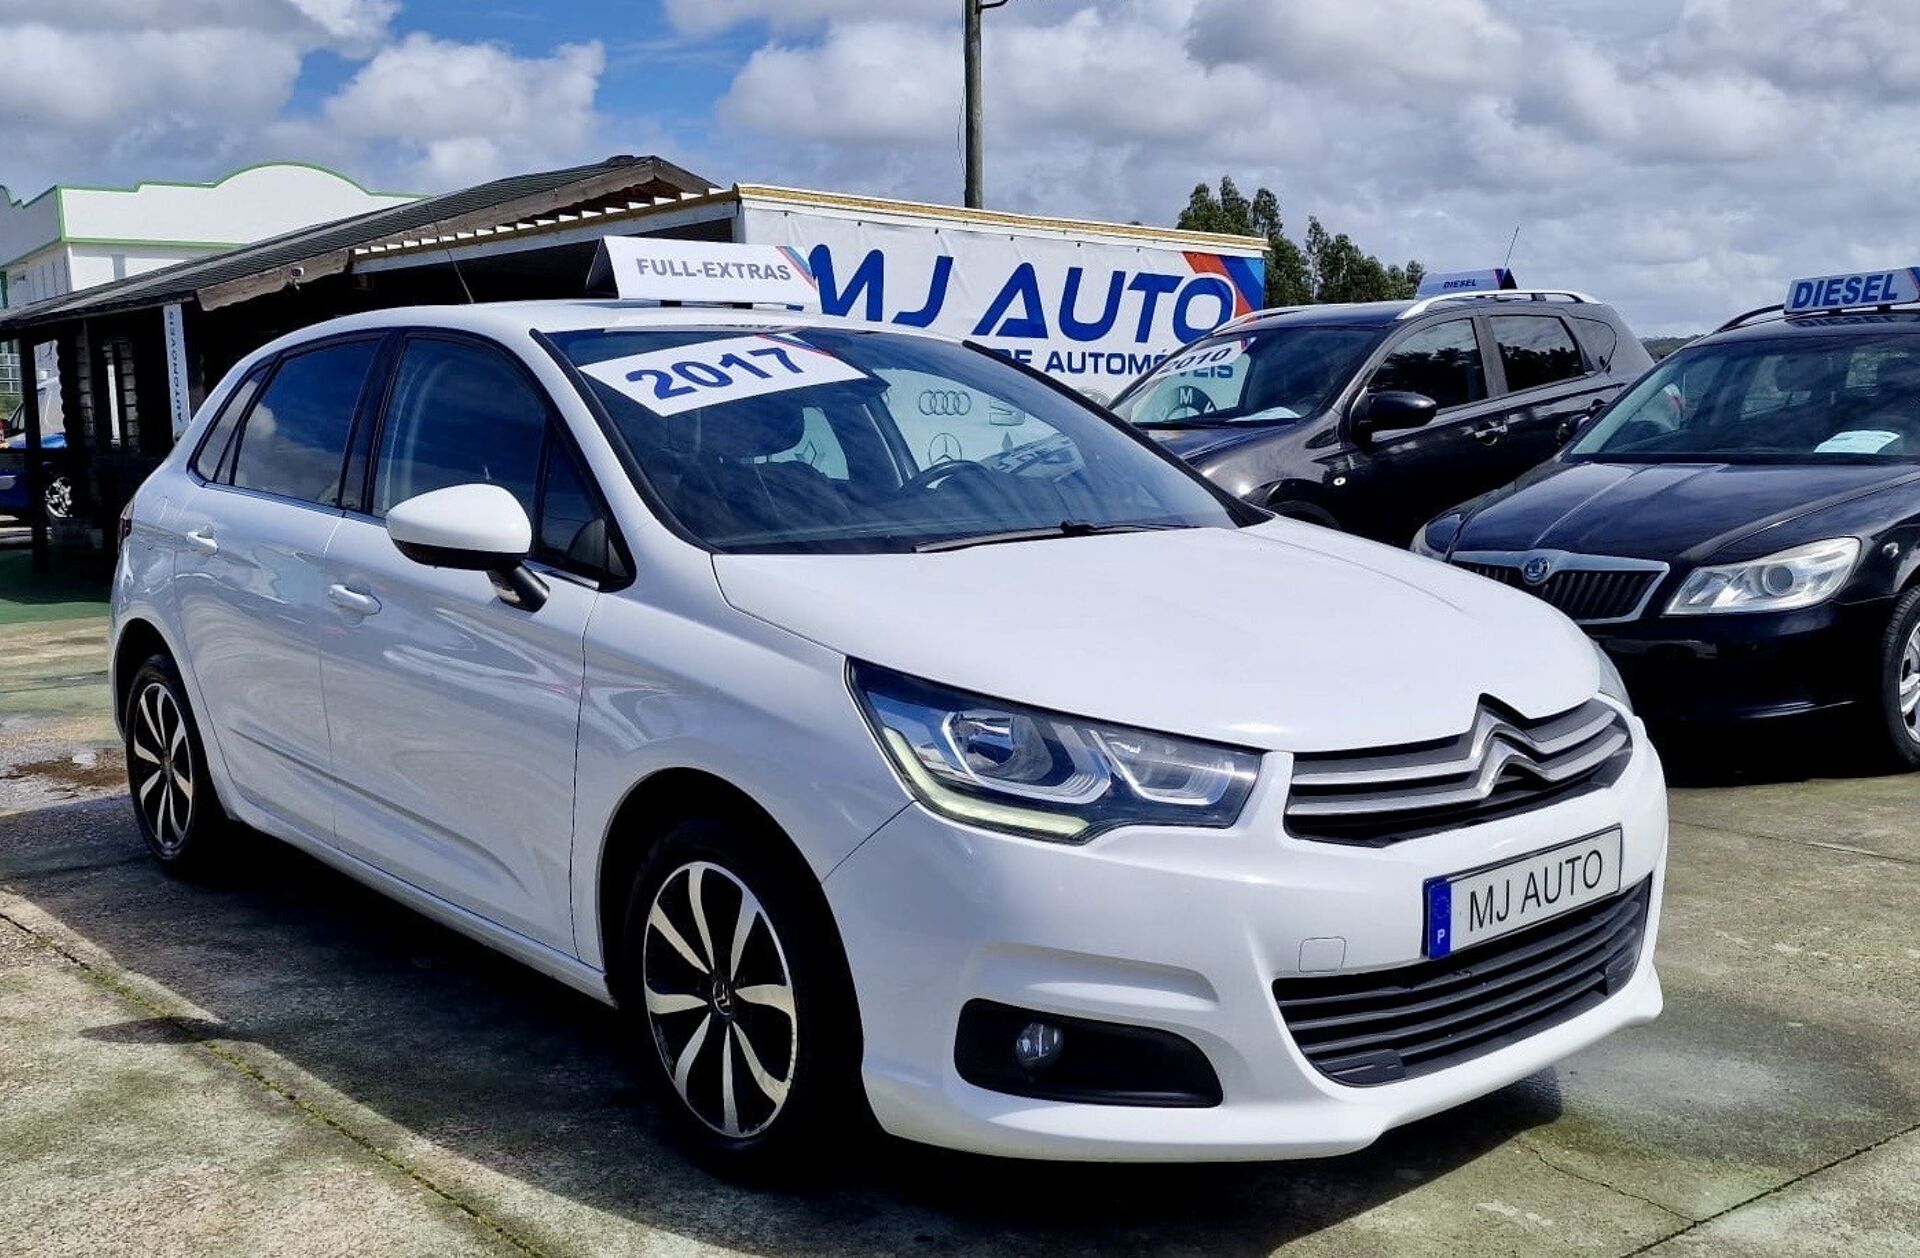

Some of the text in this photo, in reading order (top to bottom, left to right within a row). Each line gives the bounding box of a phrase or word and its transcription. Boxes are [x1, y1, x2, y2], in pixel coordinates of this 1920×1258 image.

[636, 257, 791, 280] FULL-EXTRAS
[1443, 279, 1477, 289] DIESEL
[808, 244, 1235, 343] MJ AUTO
[1791, 273, 1898, 308] DIESEL
[625, 347, 804, 400] 2017
[1469, 849, 1603, 931] MJ AUTO
[1436, 928, 1446, 944] P
